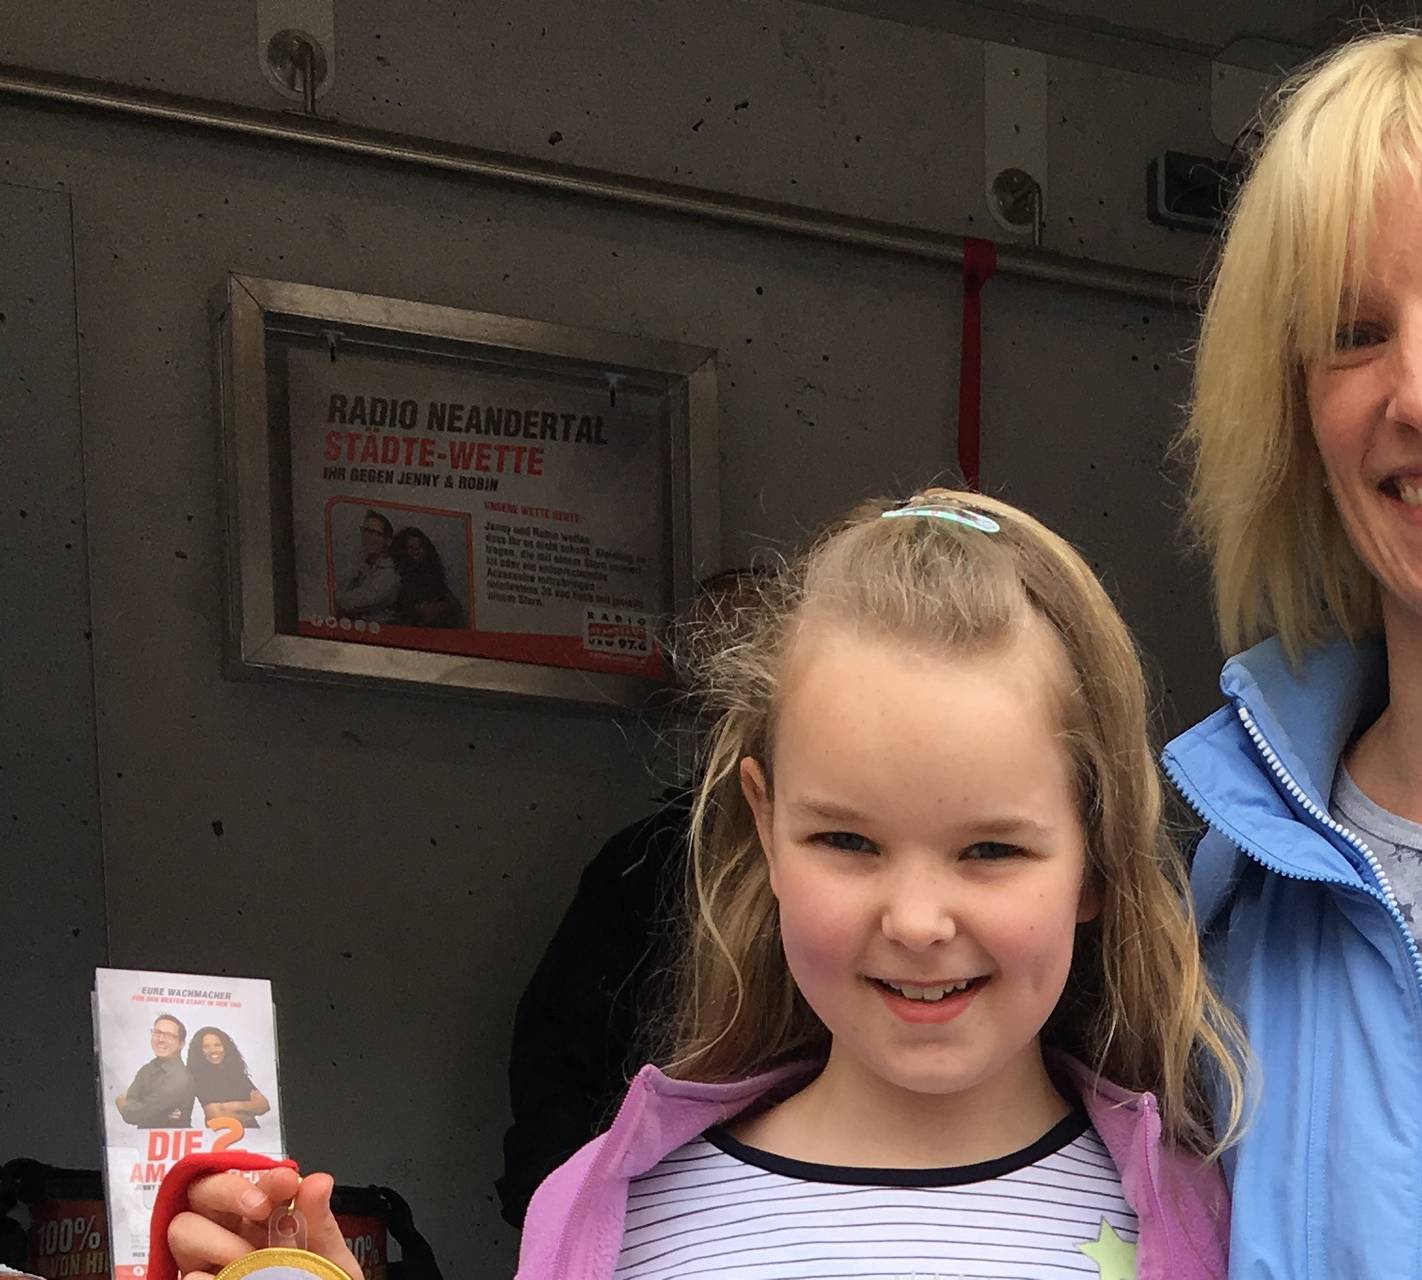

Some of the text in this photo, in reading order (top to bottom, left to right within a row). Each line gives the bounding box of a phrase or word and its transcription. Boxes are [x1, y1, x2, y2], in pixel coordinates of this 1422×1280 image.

[327, 394, 608, 444] RADIO NEANDERTAL
[323, 428, 544, 476] STÄDTE-WETTE
[323, 466, 498, 491] IHR GEGEN JENNY & ROBIN
[141, 986, 232, 1000] EURE WACHMACHER
[147, 1116, 246, 1161] DIE 2
[37, 1215, 101, 1256] 100%
[48, 1253, 80, 1278] VON
